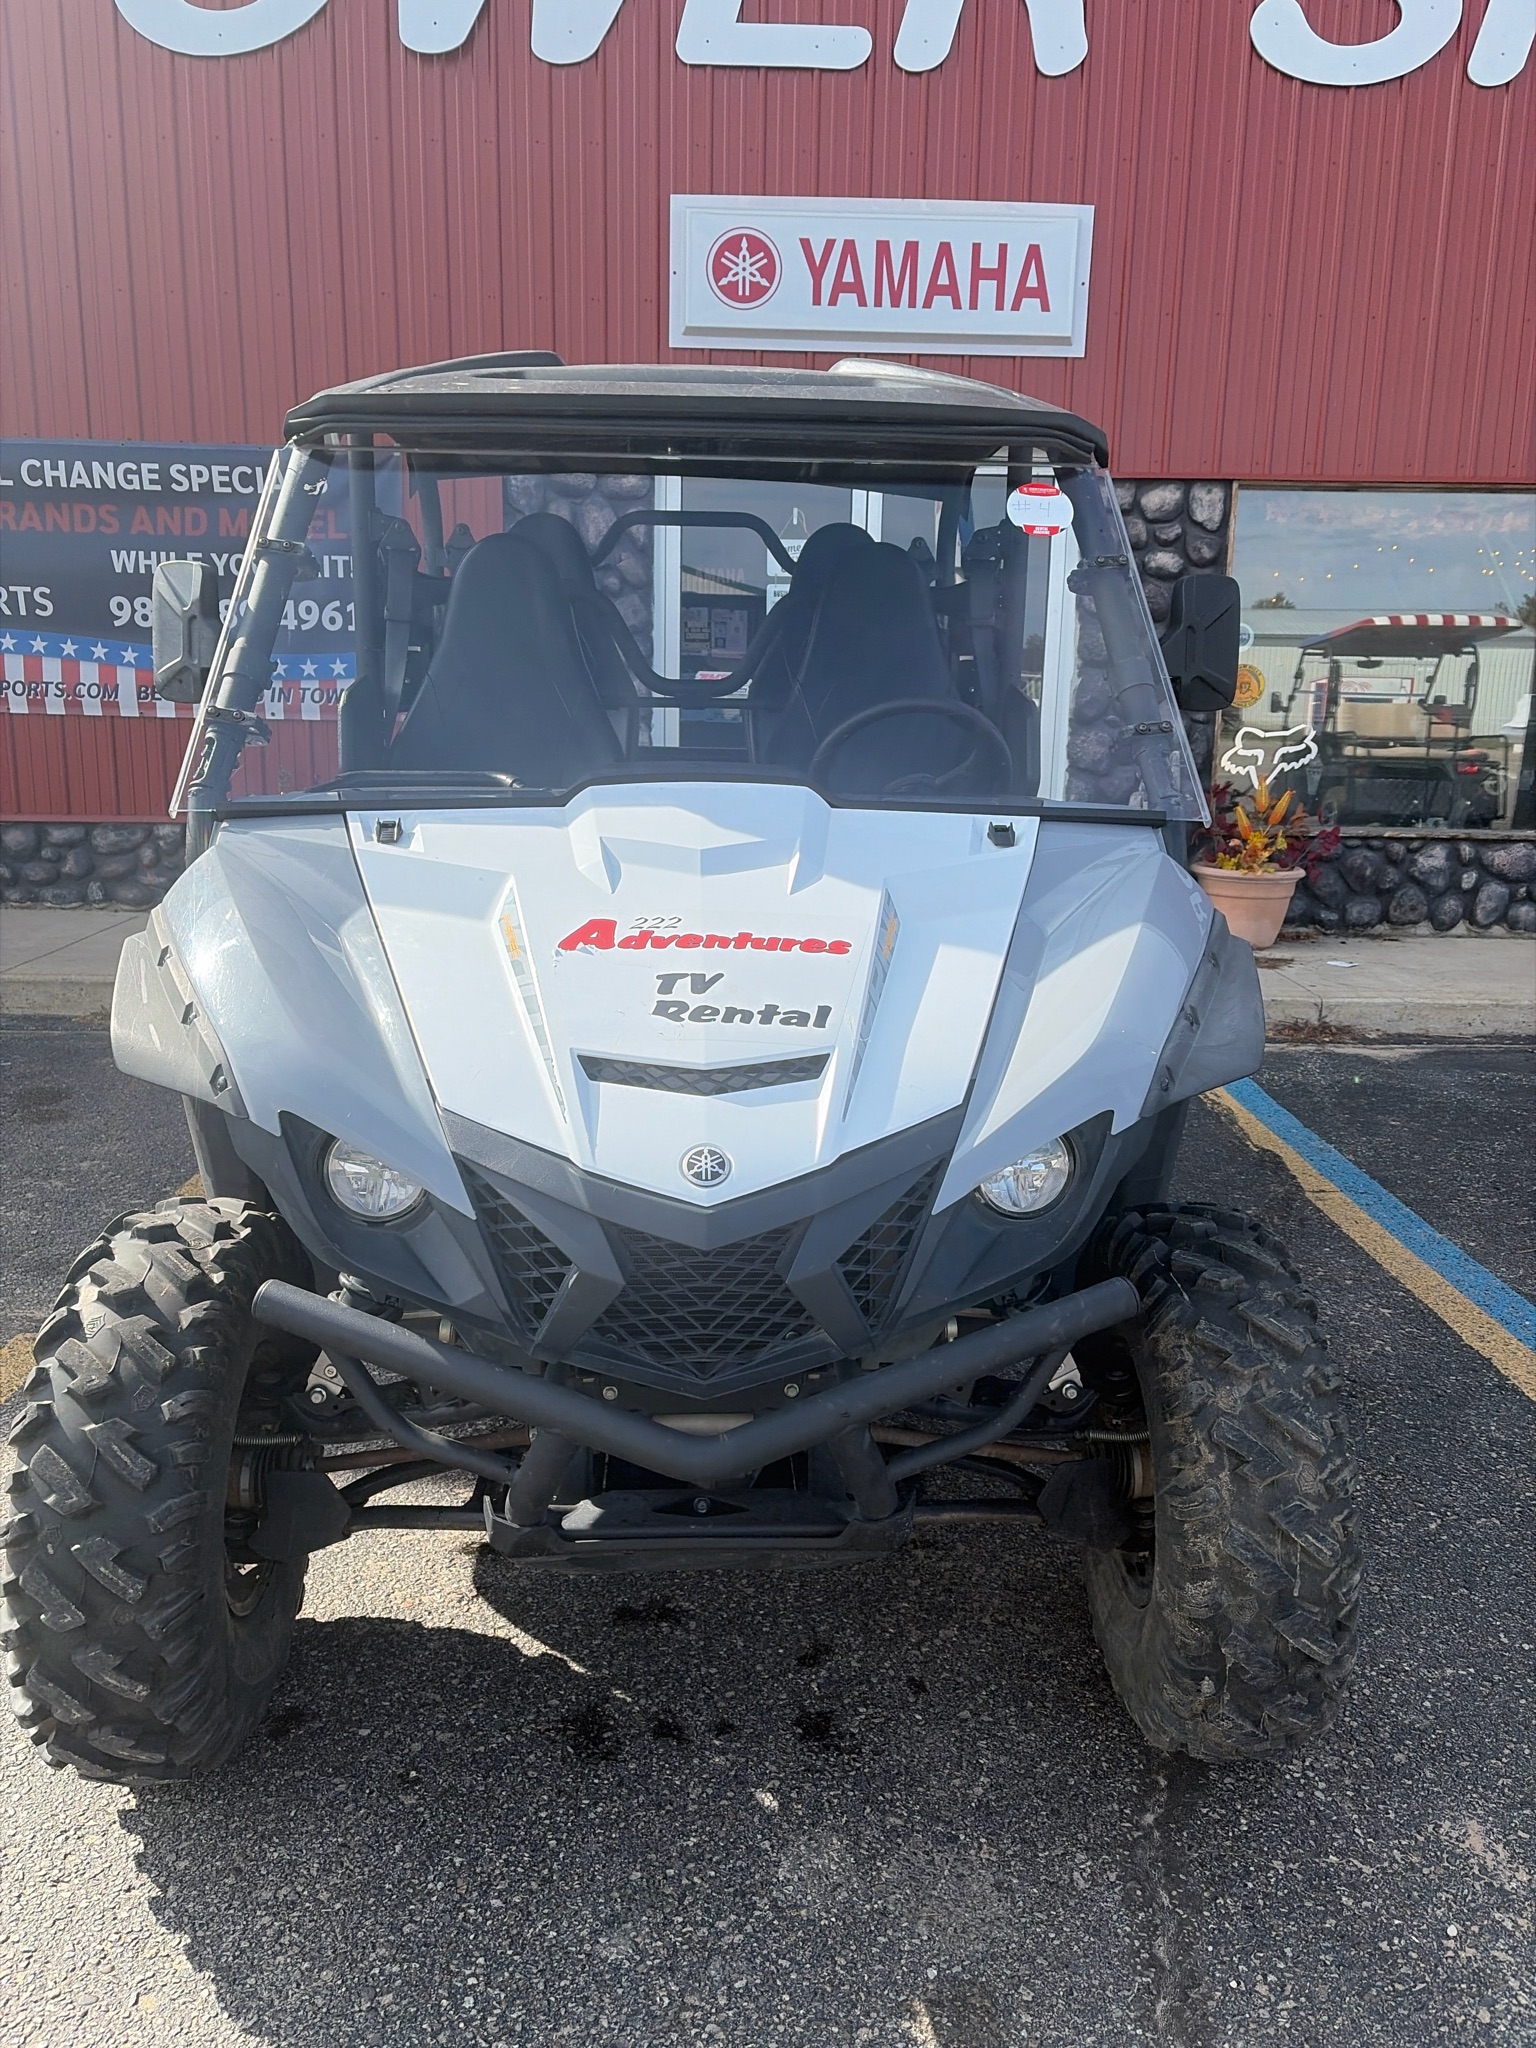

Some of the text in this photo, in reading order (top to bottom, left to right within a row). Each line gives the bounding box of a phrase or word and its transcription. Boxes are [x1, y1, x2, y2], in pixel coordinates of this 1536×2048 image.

[797, 237, 1052, 313] YAMAHA
[20, 458, 162, 491] CHANGE
[0, 501, 120, 534] RANDS
[130, 505, 208, 536] AND
[269, 686, 295, 705] IN
[299, 687, 346, 706] TOW
[557, 918, 853, 955] Adventures
[629, 916, 682, 930] 222
[655, 972, 725, 996] TV
[651, 1000, 833, 1029] Rental
